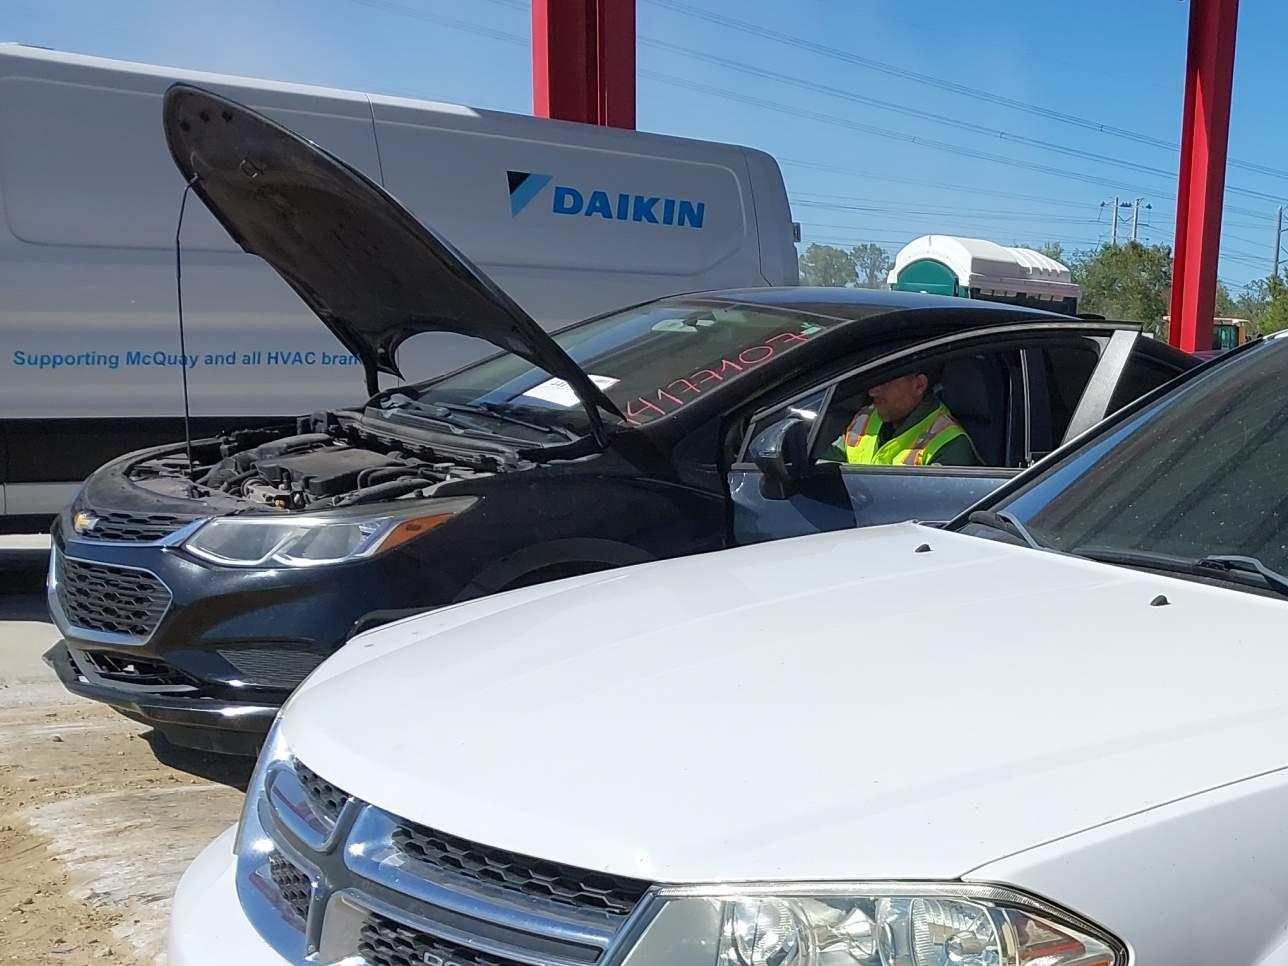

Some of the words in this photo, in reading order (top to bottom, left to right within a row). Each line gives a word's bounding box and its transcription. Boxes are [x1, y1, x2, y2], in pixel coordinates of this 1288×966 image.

[553, 186, 705, 228] DAIKIN
[13, 350, 119, 368] Supporting
[126, 351, 199, 368] McQuay
[204, 352, 236, 365] and
[242, 352, 262, 365] all
[267, 352, 316, 365] HVAC
[321, 352, 361, 365] bran
